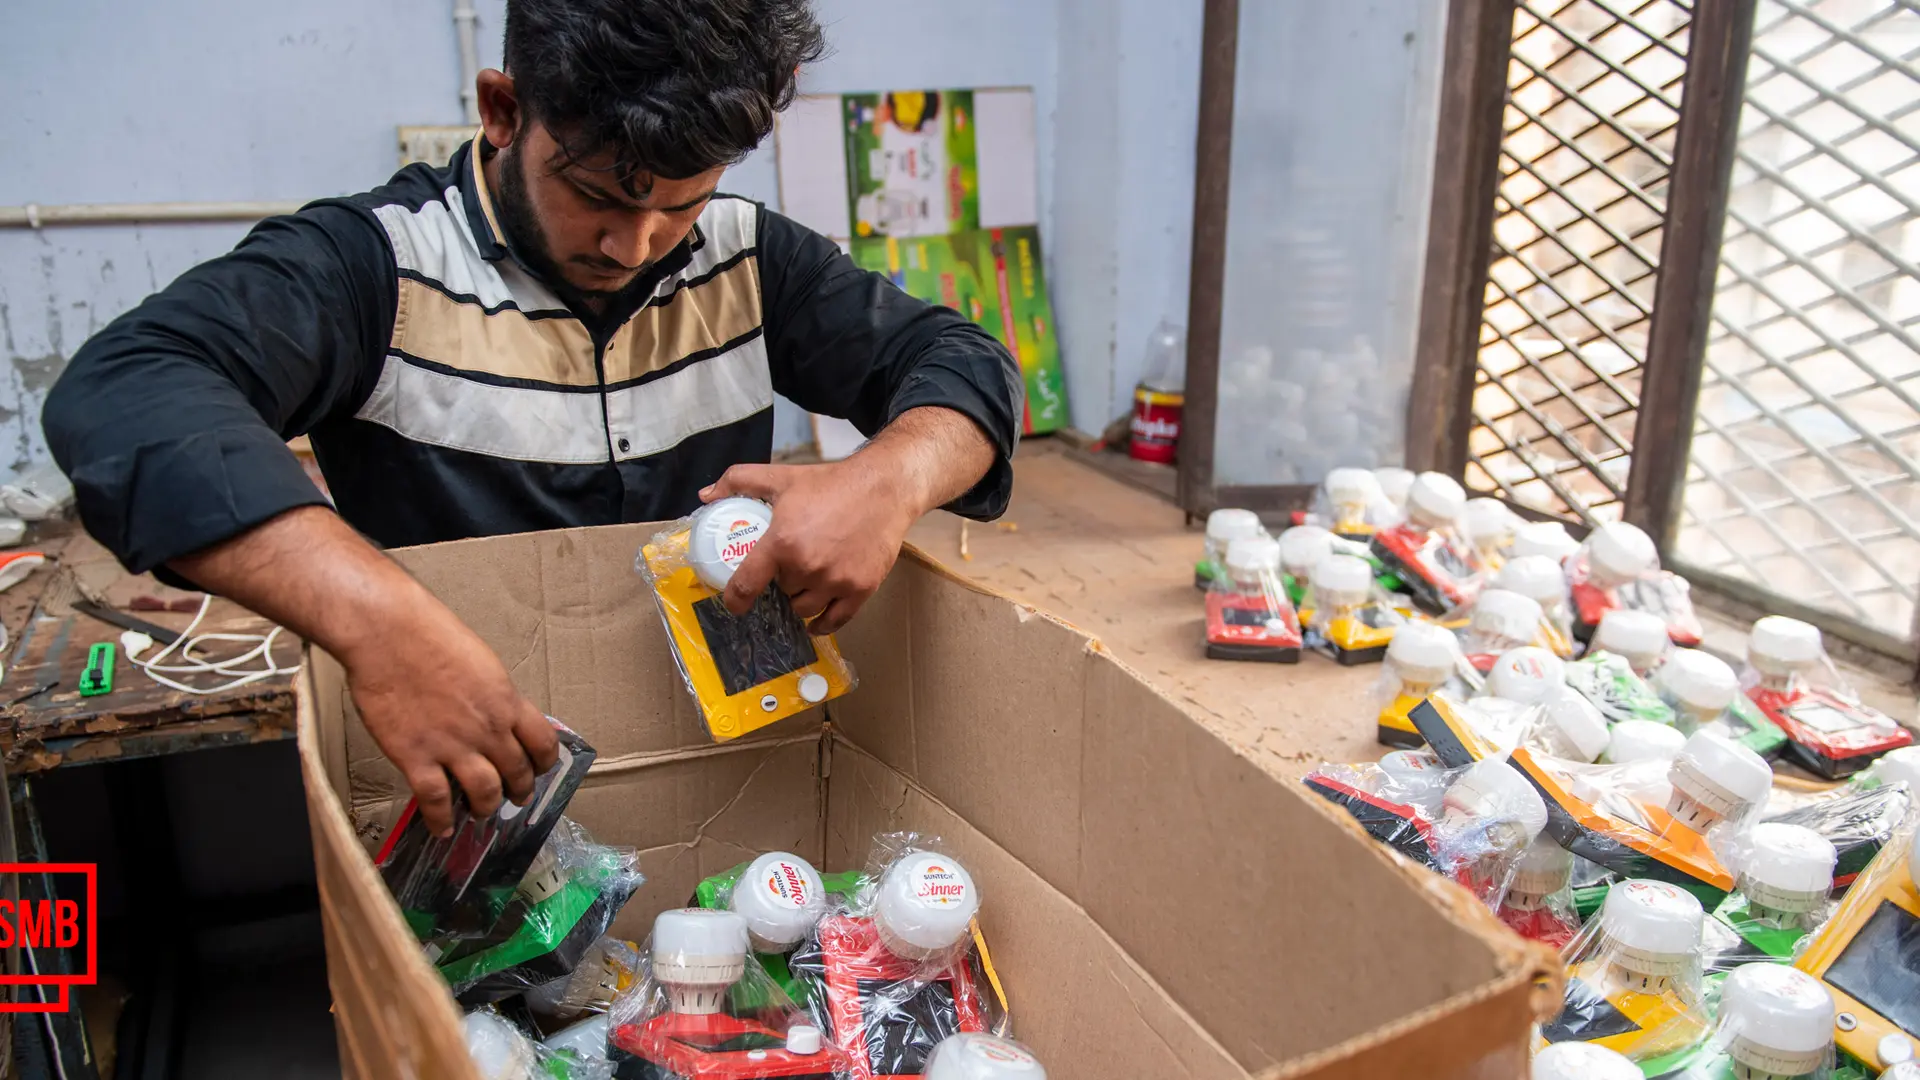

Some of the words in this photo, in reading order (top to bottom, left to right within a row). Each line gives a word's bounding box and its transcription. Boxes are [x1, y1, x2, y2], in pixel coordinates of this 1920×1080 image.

[726, 525, 759, 541] SUNTECH
[773, 870, 788, 898] SUNTECH
[780, 862, 806, 905] Winner
